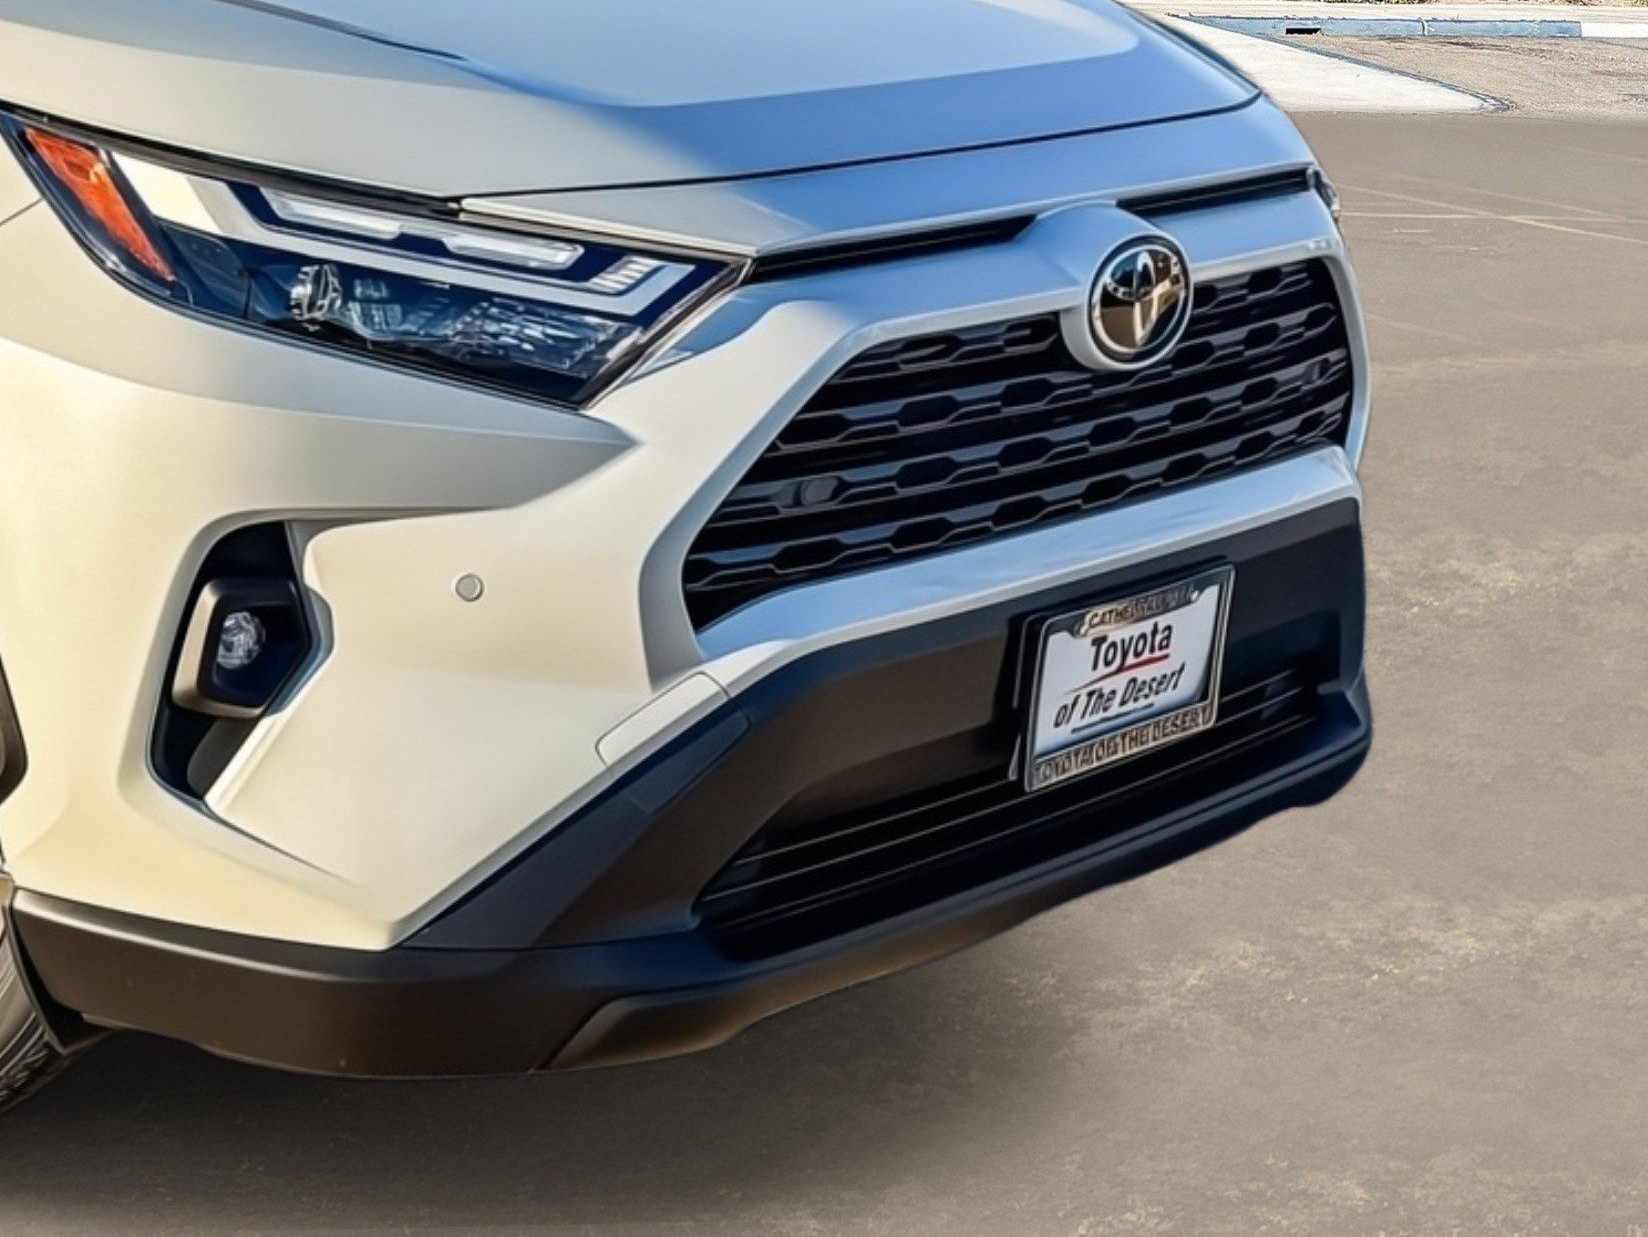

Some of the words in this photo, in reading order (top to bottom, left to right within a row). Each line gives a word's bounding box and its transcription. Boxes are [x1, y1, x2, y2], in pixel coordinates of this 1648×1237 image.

[1091, 621, 1173, 671] Toyota
[1053, 694, 1081, 729] of
[1079, 686, 1117, 720] The
[1119, 662, 1185, 705] Desert
